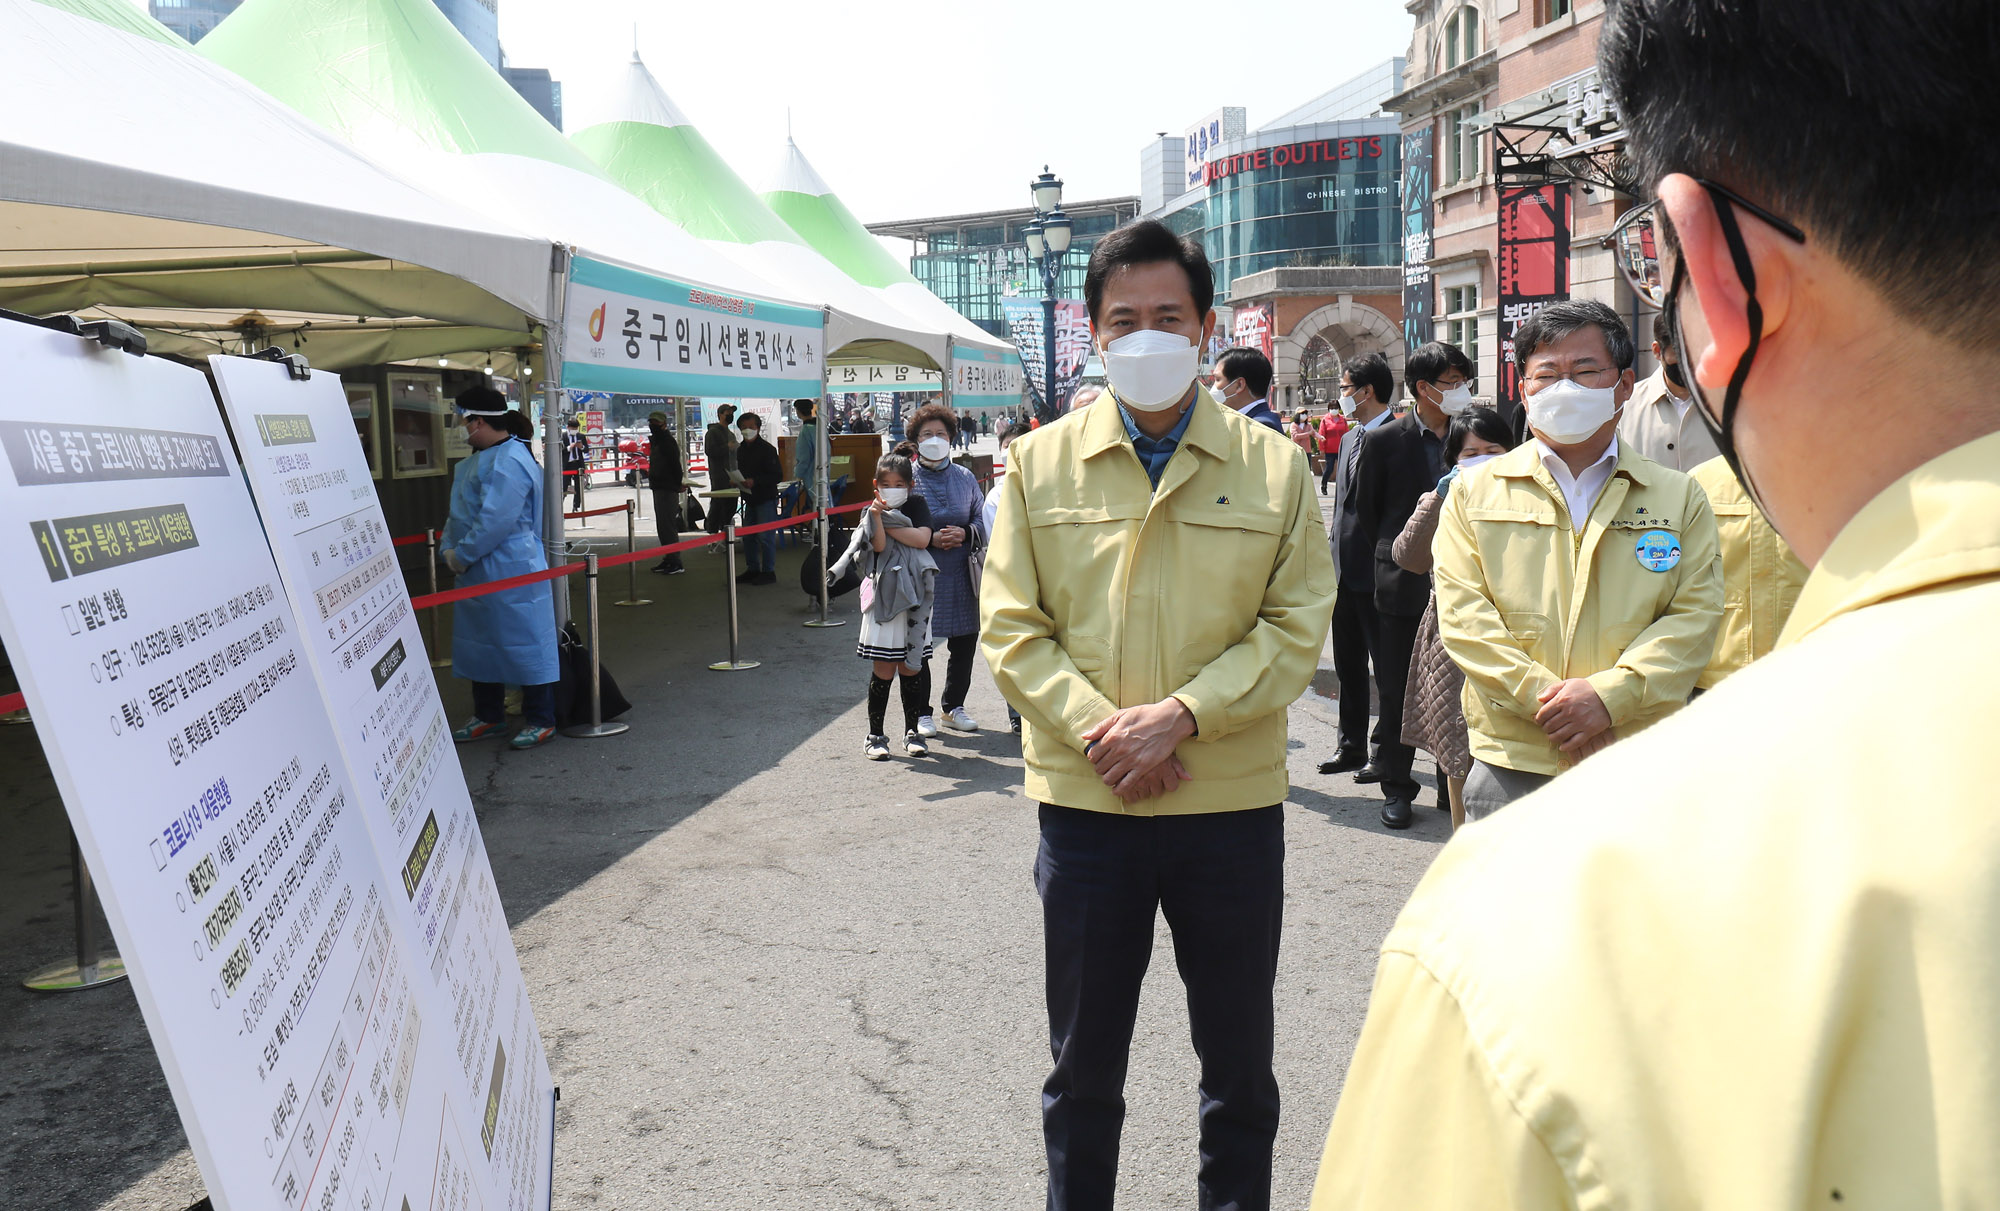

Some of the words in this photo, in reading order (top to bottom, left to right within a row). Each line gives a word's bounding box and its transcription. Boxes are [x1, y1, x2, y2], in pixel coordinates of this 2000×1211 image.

[1212, 150, 1267, 180] LOTTE
[1273, 136, 1382, 167] OUTLETS
[1355, 186, 1388, 196] BISTRO
[622, 308, 797, 372] 중구임시선별검사소
[24, 428, 64, 473] 서울
[59, 430, 98, 474] 중구
[91, 432, 144, 471] 코로나19
[139, 434, 168, 471] 현황
[159, 435, 178, 470] 및
[171, 436, 208, 470] 조치사항
[199, 439, 220, 468] 보고
[40, 531, 57, 567] 1
[64, 527, 93, 564] 중구
[92, 522, 121, 557] 특성
[116, 519, 136, 553] 및
[130, 516, 163, 547] 코로나
[158, 511, 193, 543] 대응현황
[78, 595, 106, 631] 일반
[103, 588, 128, 622] 현황
[101, 648, 123, 682] 인구
[121, 701, 144, 728] 특성
[148, 678, 178, 714] 유동인구
[183, 716, 213, 753] 롯데호텔
[207, 709, 220, 736] 등
[163, 804, 203, 857] 코로나19
[199, 776, 232, 820] 대응현황
[217, 829, 240, 865] 서울시
[263, 784, 275, 814] 중구
[240, 863, 263, 902] 중구민
[271, 1079, 299, 1140] 세부내역
